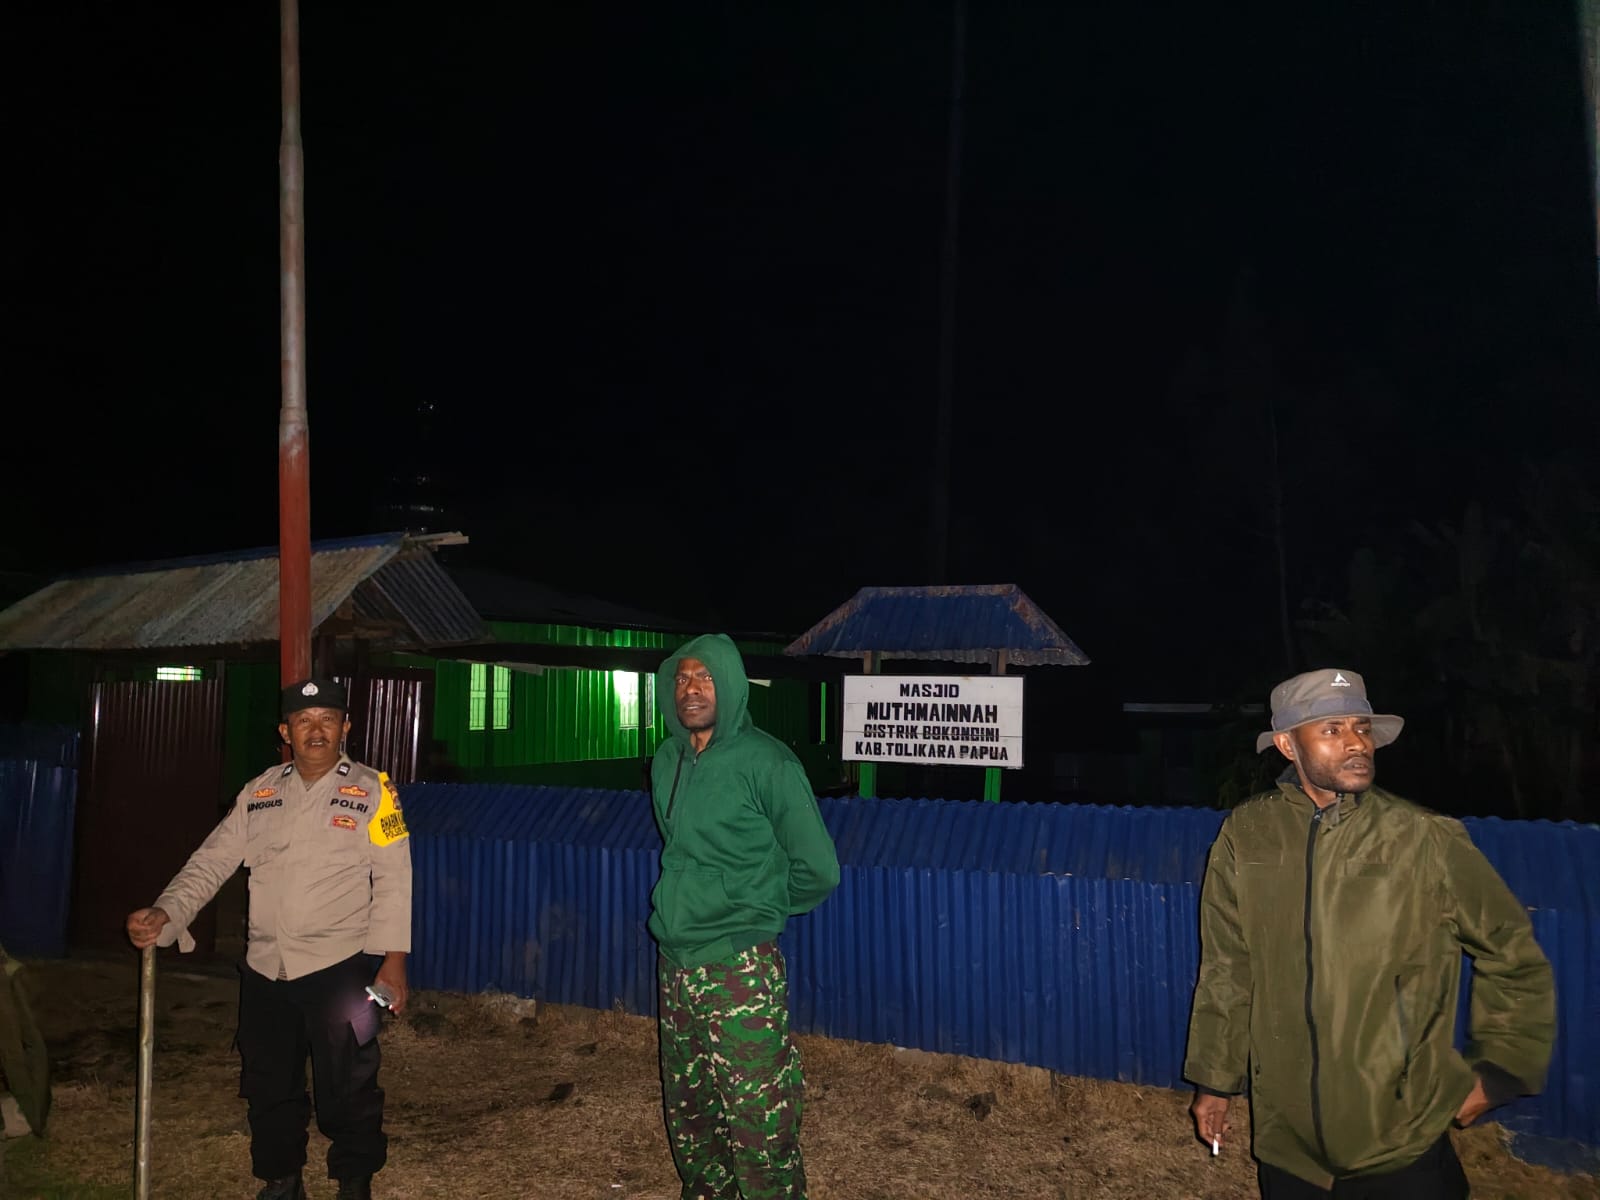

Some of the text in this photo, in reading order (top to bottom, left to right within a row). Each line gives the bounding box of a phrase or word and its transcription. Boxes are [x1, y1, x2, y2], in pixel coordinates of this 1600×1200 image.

[900, 683, 959, 698] MASJID
[867, 702, 997, 723] MUTHMAINNAH
[959, 745, 1008, 760] PAPUA
[330, 799, 368, 813] POLRI
